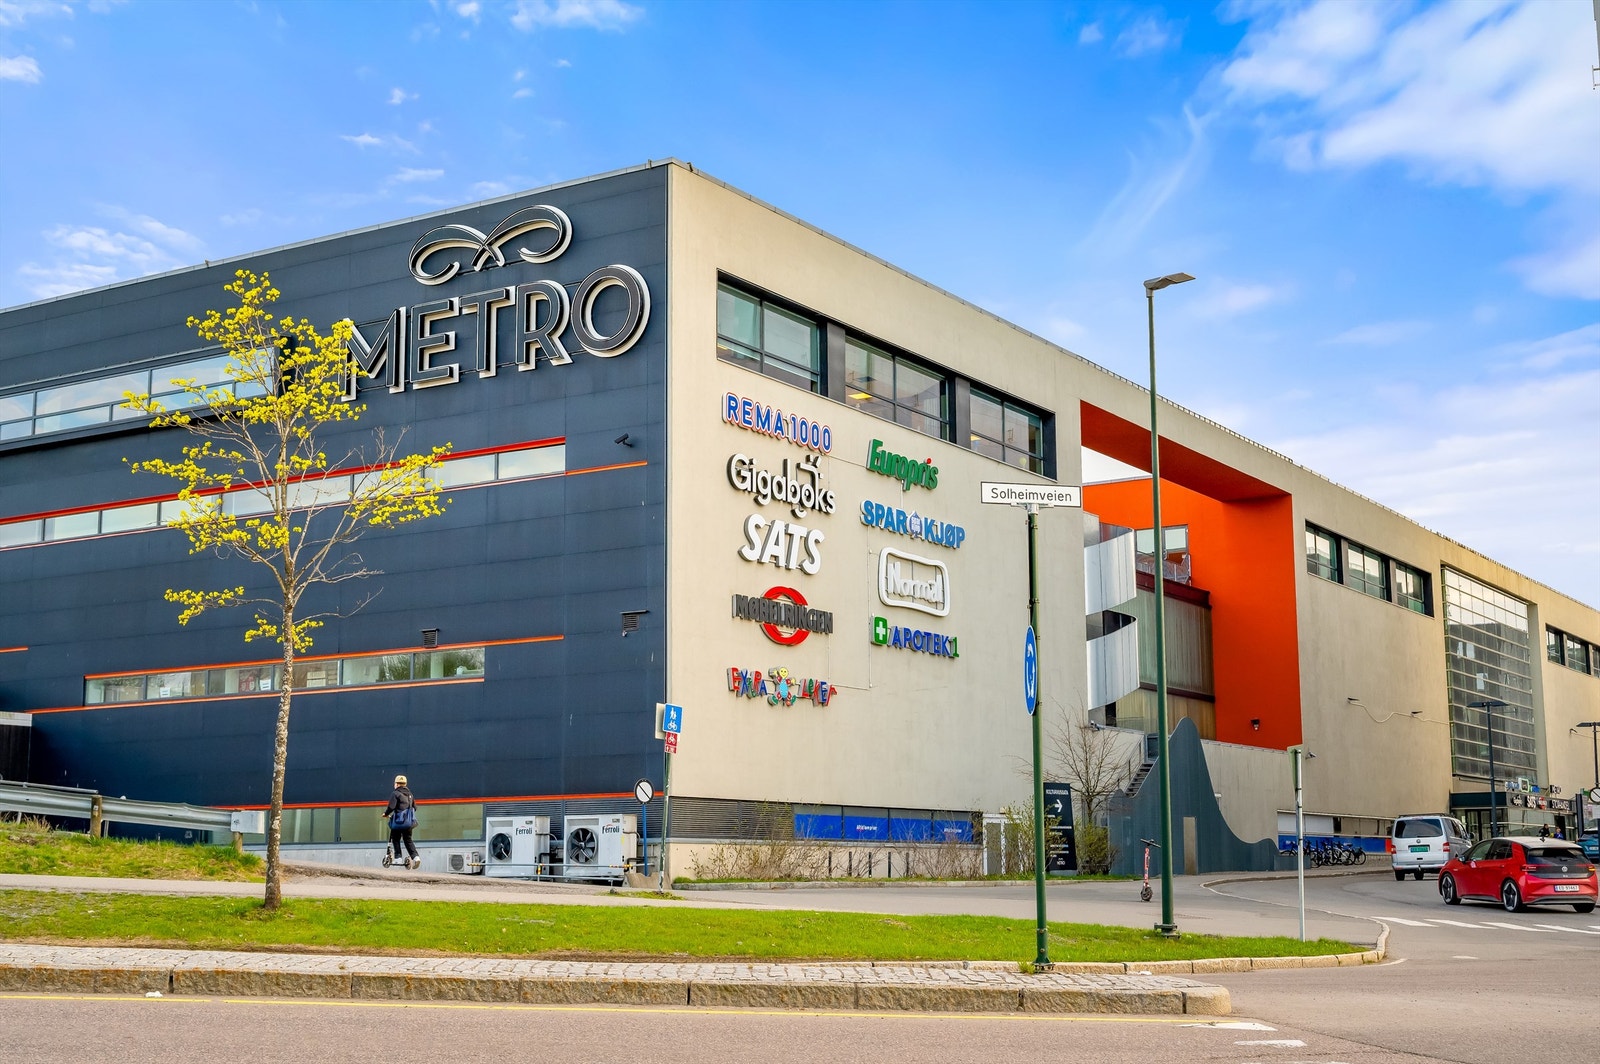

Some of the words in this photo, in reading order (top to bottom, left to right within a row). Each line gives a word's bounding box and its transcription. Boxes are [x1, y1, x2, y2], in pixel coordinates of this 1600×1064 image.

[341, 264, 651, 402] METRO
[724, 392, 785, 440] REMA
[789, 413, 833, 454] 1000
[866, 438, 939, 491] Europris
[990, 487, 1072, 502] Solheimveien
[738, 513, 825, 576] SATS
[861, 499, 909, 536] SPAR
[923, 516, 966, 549] KJØP
[887, 561, 943, 603] Normal
[732, 594, 834, 634] MØBELRINGEN
[515, 827, 533, 836] Ferroli
[602, 825, 620, 834] Ferroli
